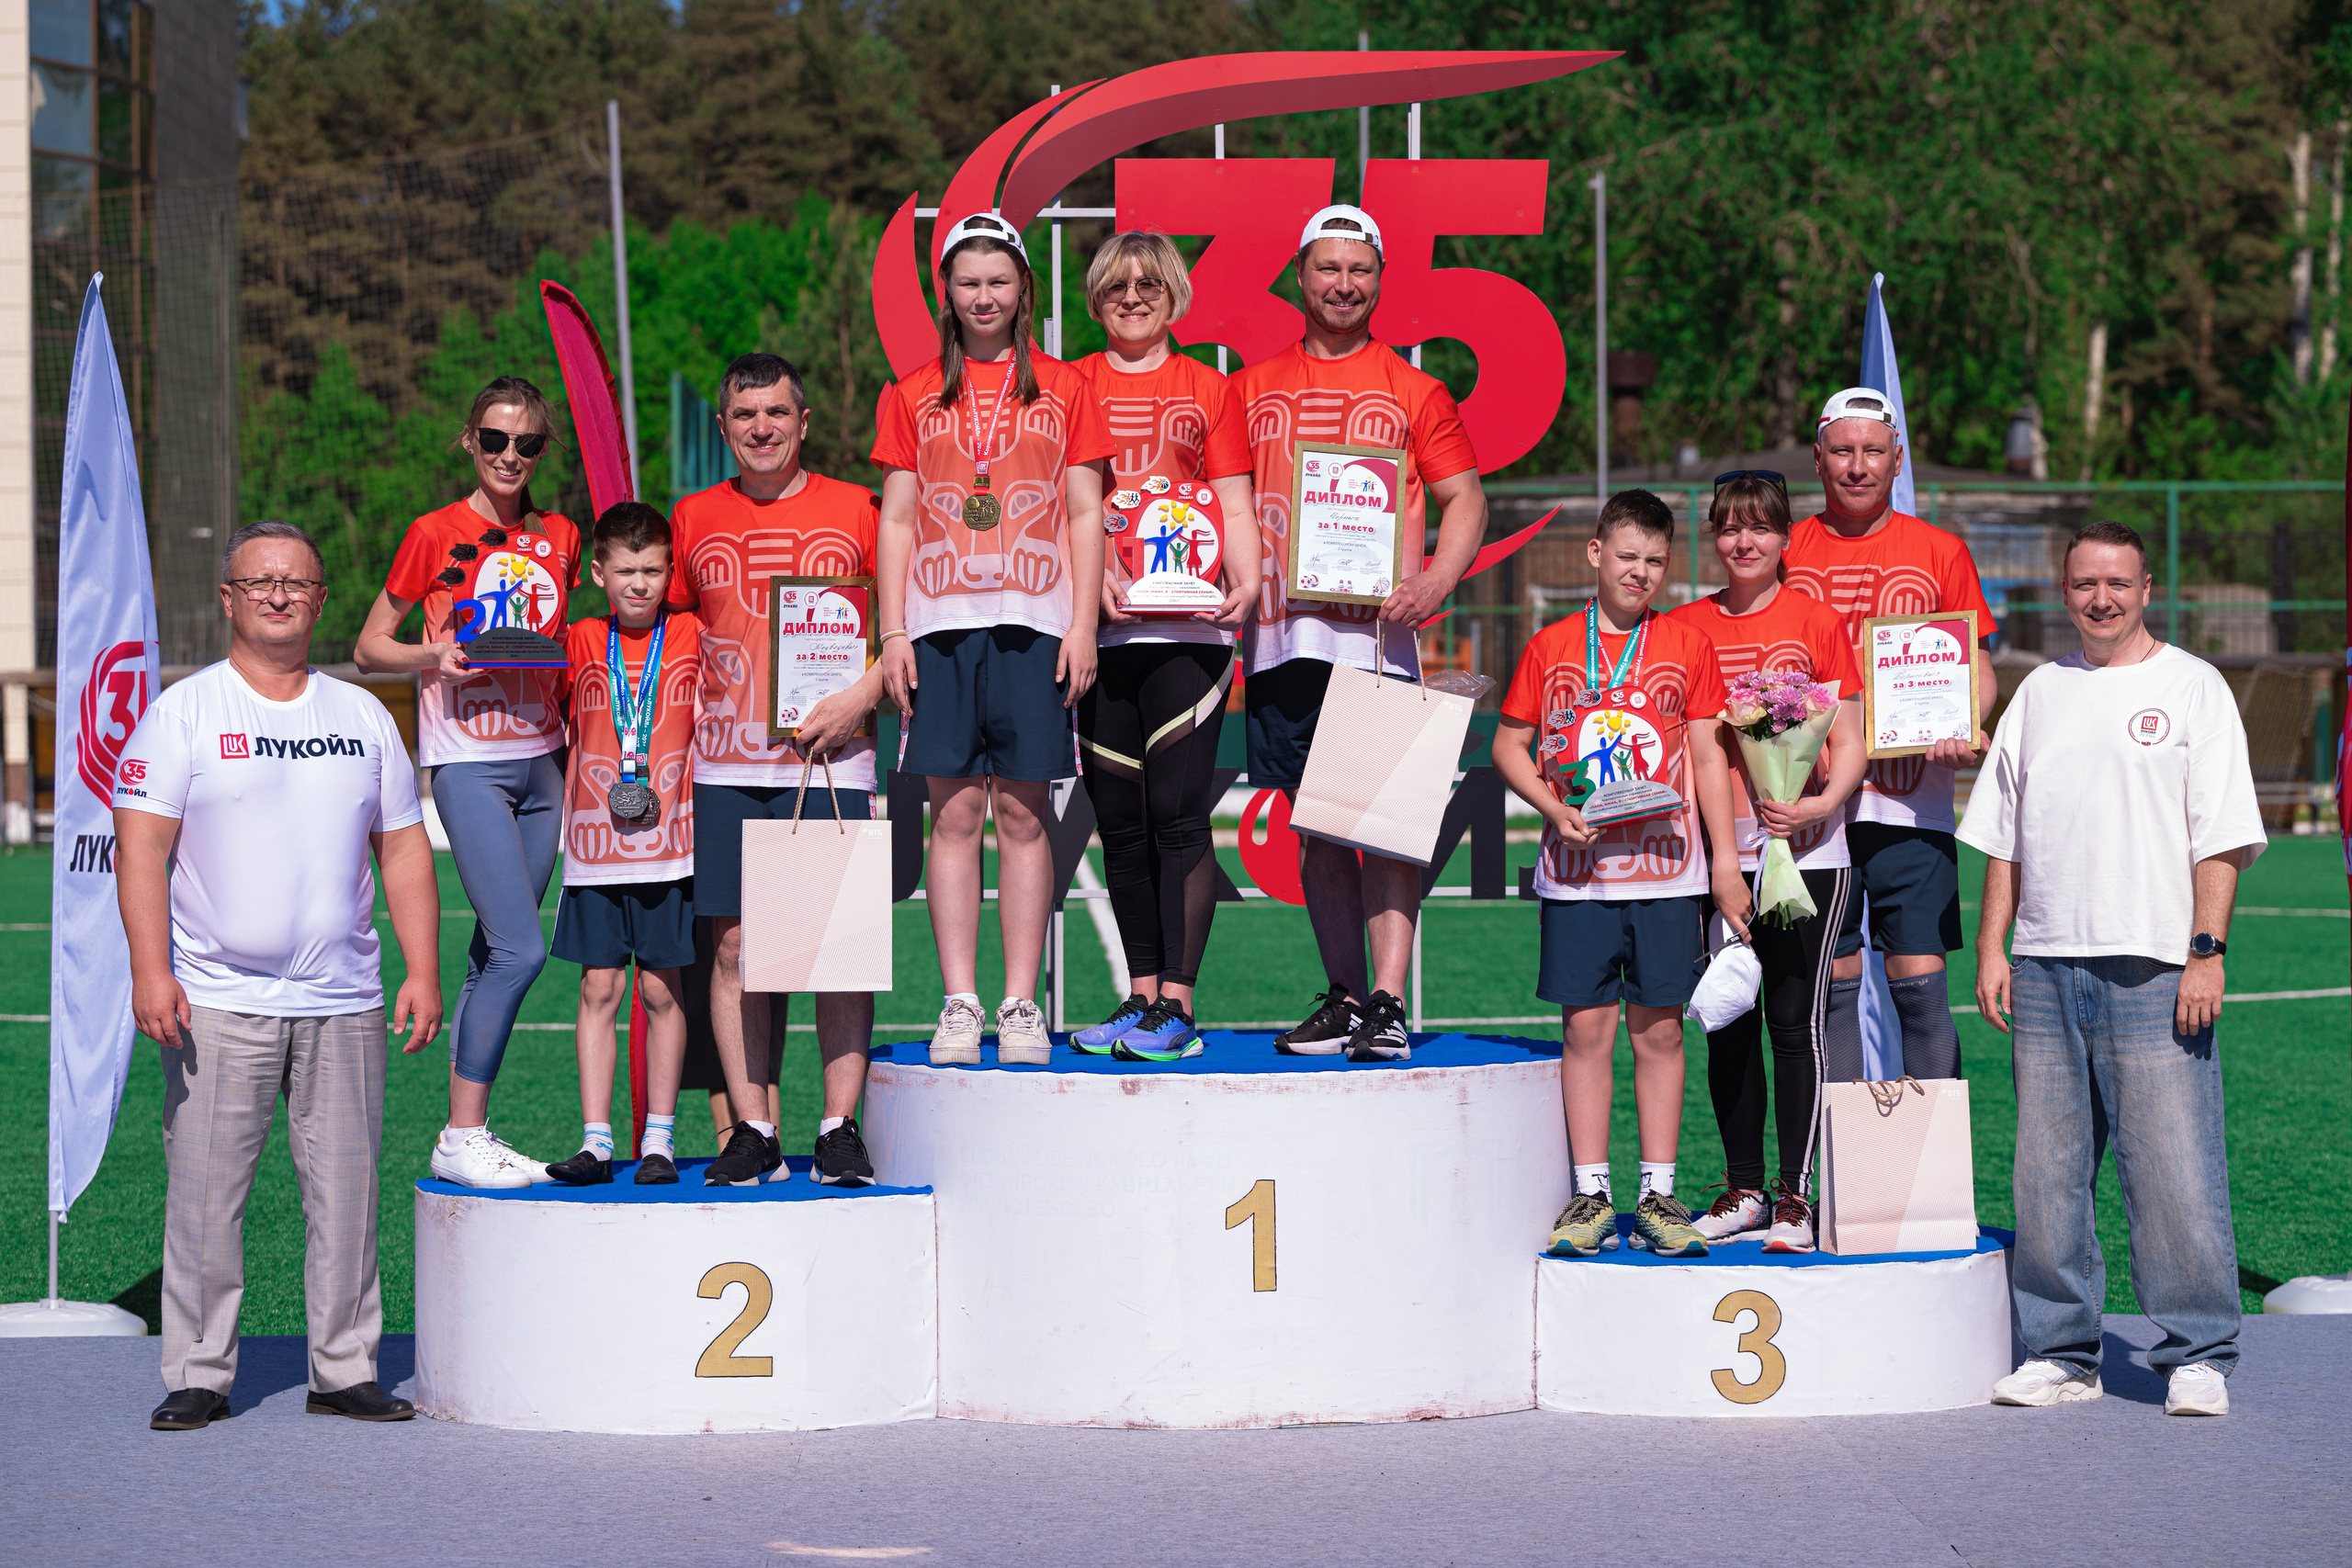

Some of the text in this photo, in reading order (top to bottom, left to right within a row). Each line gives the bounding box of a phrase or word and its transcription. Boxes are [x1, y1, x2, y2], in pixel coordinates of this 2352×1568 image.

[1304, 491, 1382, 508] ДИПЛОМ
[1342, 524, 1374, 533] место
[454, 599, 486, 642] 2
[783, 622, 854, 635] ДИПЛОМ
[1877, 652, 1955, 669] ДИПЛОМ
[254, 734, 365, 760] ЛУКОЙЛ
[126, 763, 146, 779] 35
[1558, 761, 1596, 805] 3
[117, 787, 147, 798] ЛУКОЙЛ
[70, 834, 117, 874] ЛУК
[1224, 1179, 1277, 1293] 1
[695, 1261, 774, 1378] 2
[1710, 1289, 1786, 1404] 3
